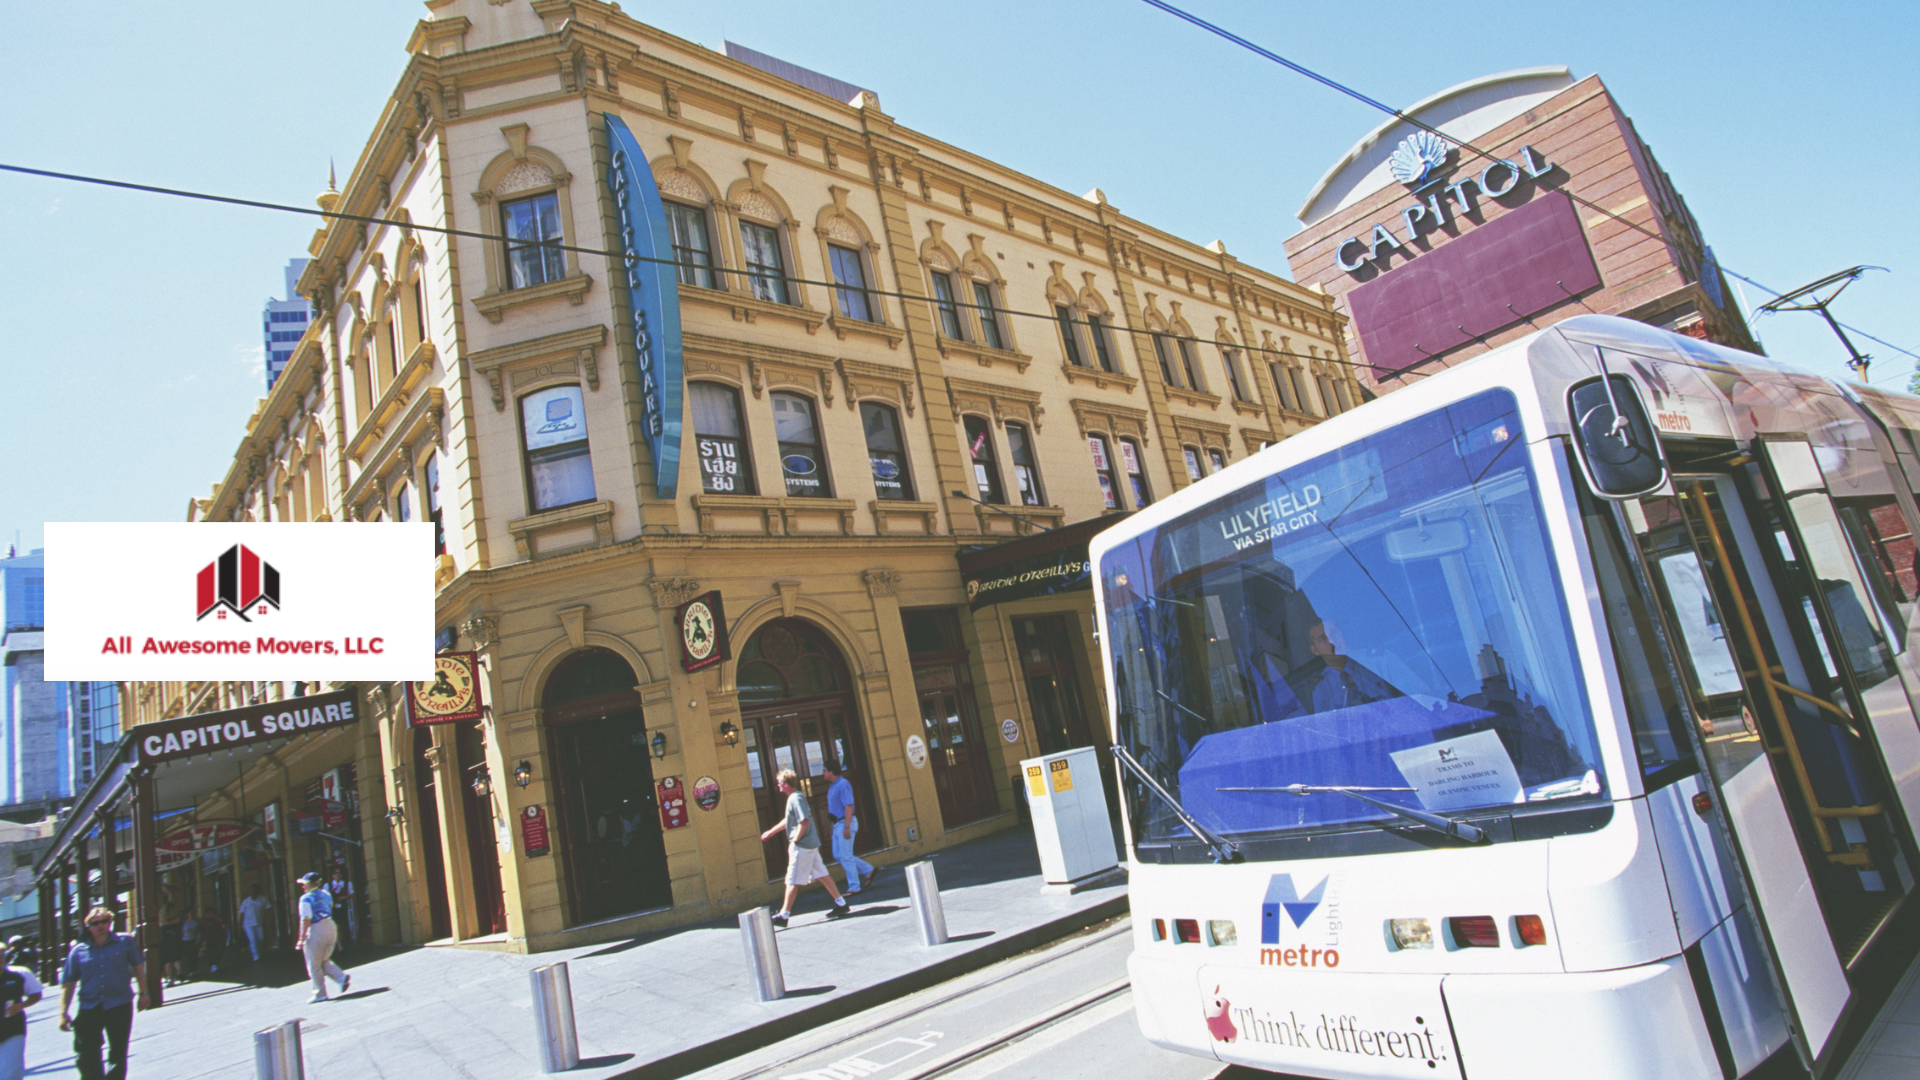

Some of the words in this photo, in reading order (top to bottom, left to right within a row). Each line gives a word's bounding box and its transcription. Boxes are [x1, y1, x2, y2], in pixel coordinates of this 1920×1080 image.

[1335, 145, 1553, 272] CAPITOL
[612, 149, 641, 290] CAPITOL
[634, 308, 662, 437] SQUARE
[1657, 410, 1692, 432] metro
[784, 477, 820, 487] SYSTEMS
[874, 480, 901, 489] SYSTEMS
[1219, 483, 1322, 540] LILYFIELD
[1232, 535, 1255, 551] VIA
[1255, 521, 1289, 544] STAR
[1289, 509, 1318, 531] CITY
[143, 719, 256, 757] CAPITOL
[262, 700, 355, 734] SQUARE
[1051, 760, 1067, 772] 259
[1437, 764, 1462, 773] TRAMS
[1428, 777, 1461, 786] DARLING
[1461, 770, 1498, 780] HARBOUR
[1437, 785, 1471, 796] OLYMPIC
[170, 838, 190, 847] OPEN
[1325, 902, 1343, 946] Light
[1260, 943, 1340, 968] metro
[1234, 1007, 1312, 1049] Think
